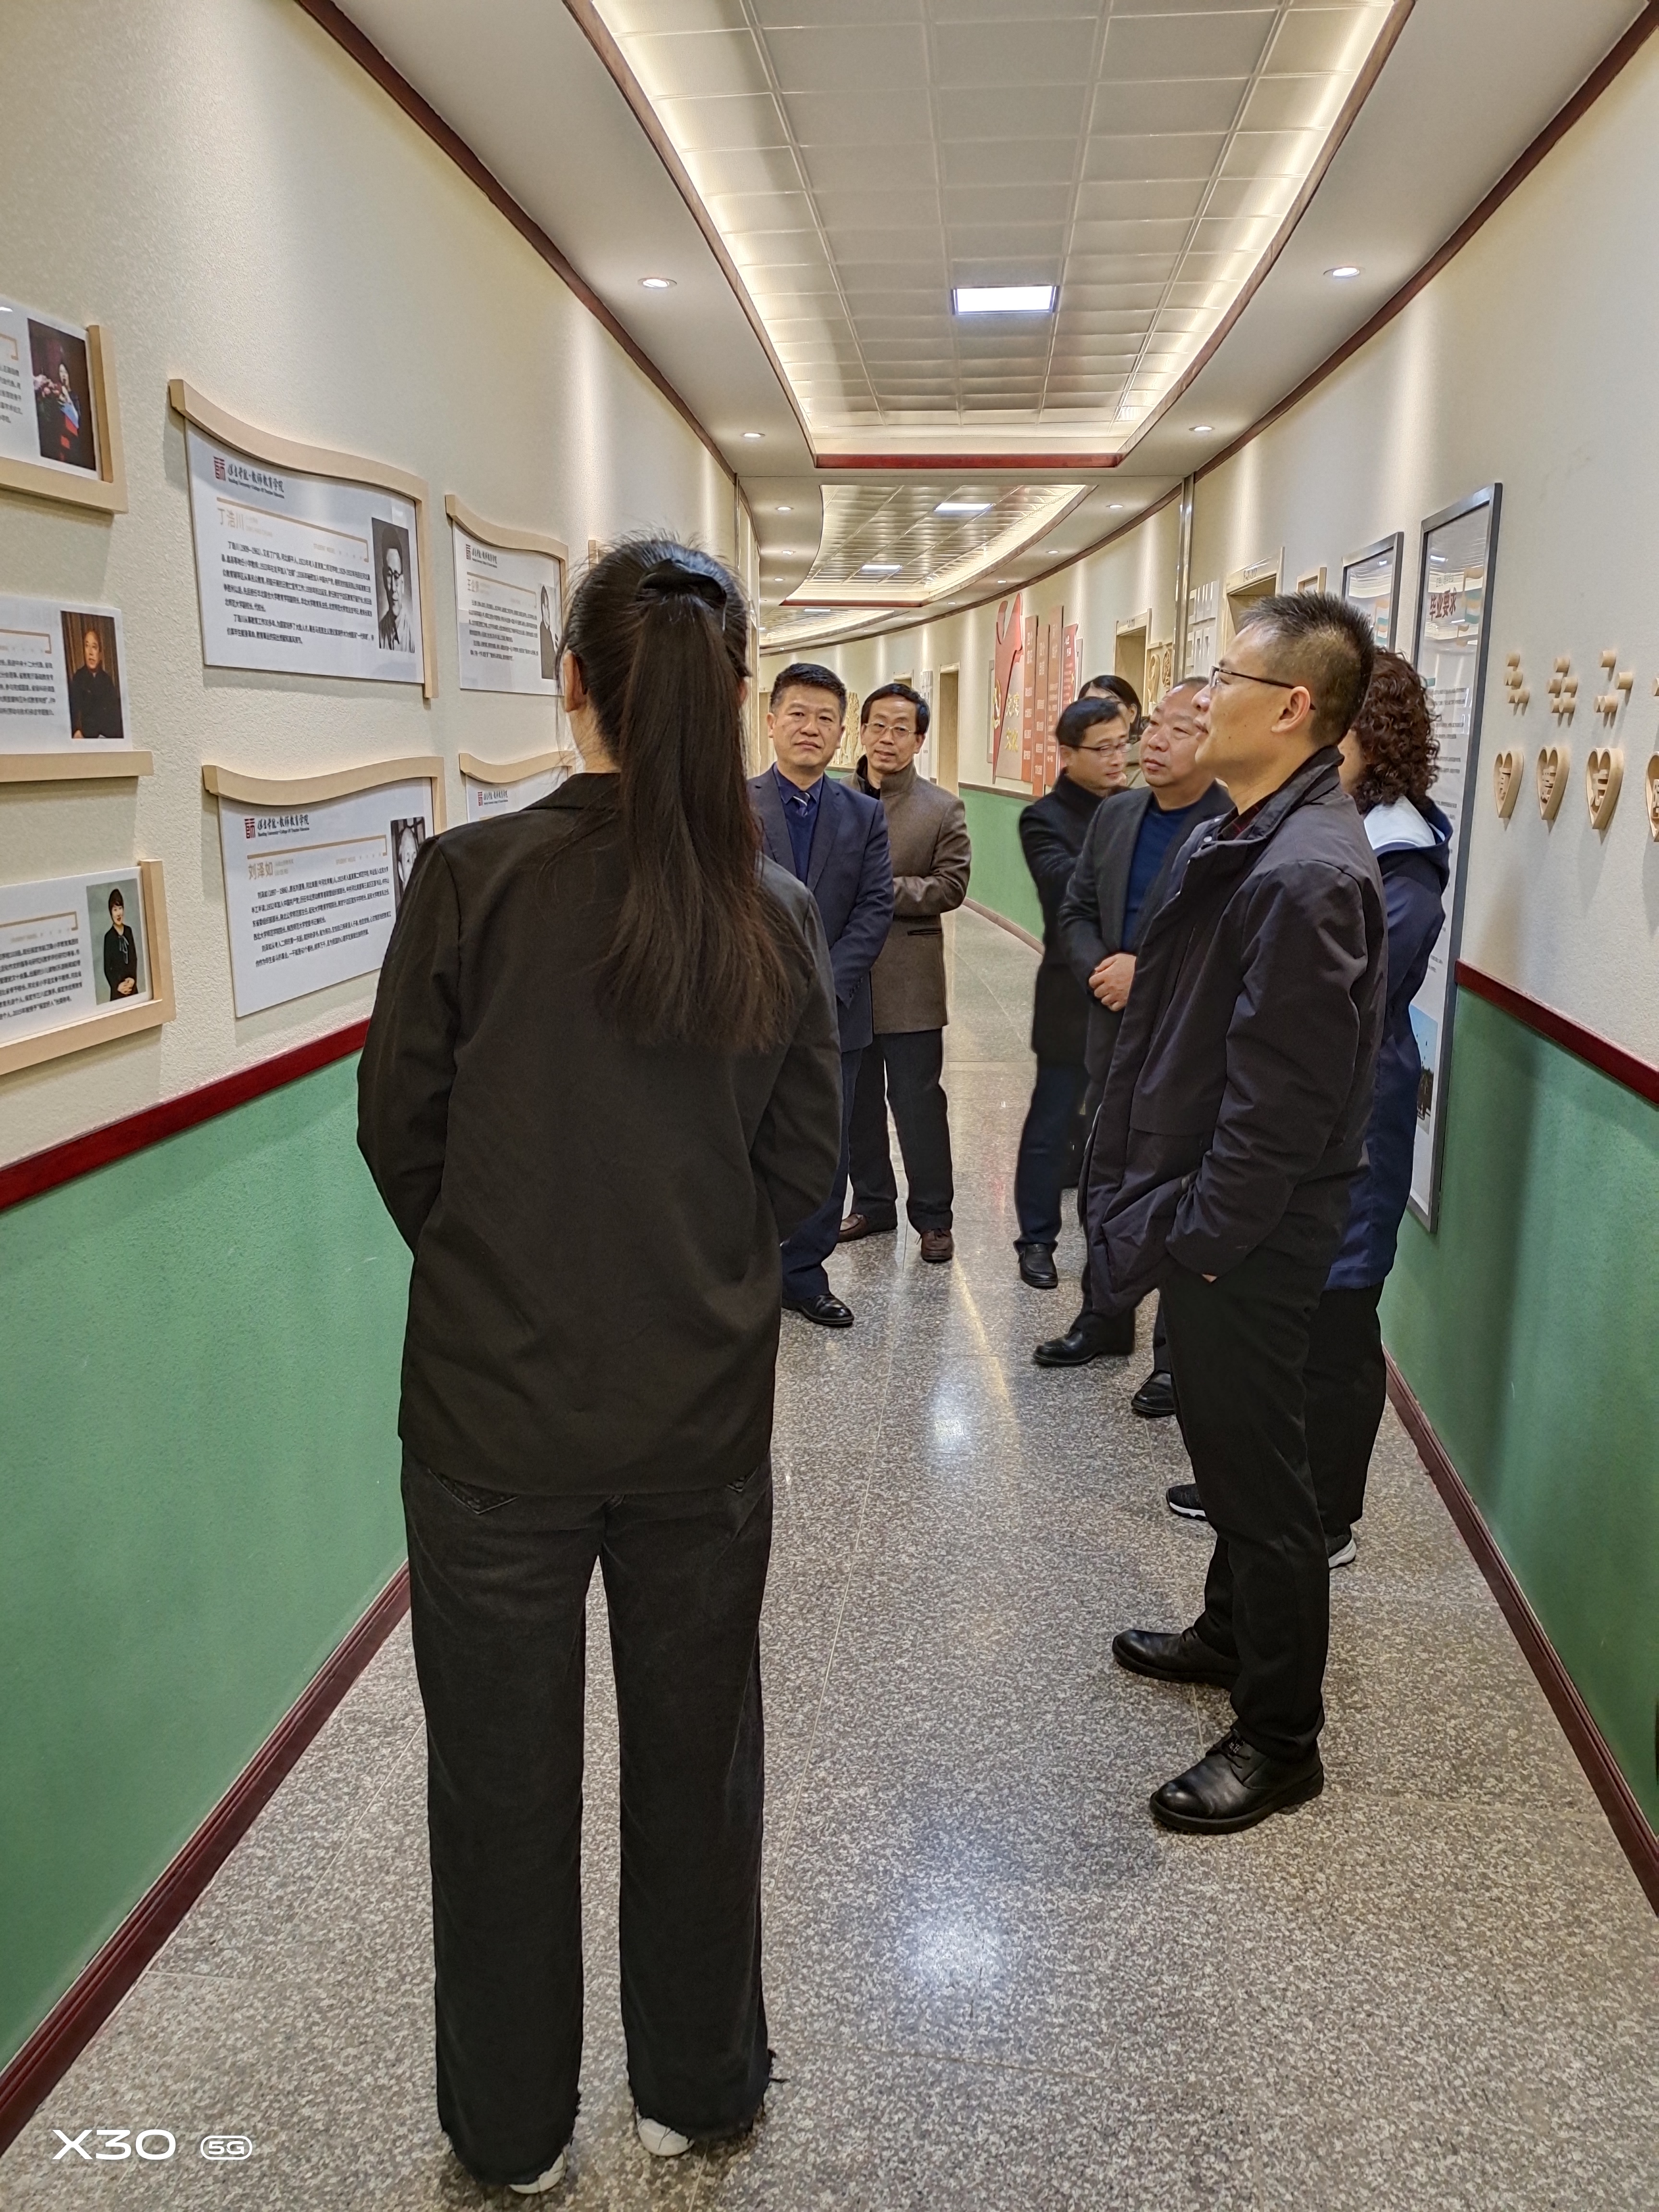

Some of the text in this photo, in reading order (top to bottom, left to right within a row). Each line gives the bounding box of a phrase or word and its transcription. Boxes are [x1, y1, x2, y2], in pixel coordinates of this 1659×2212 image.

[217, 507, 244, 531] 丁浩川
[1430, 587, 1457, 622] 毕业要求
[248, 861, 273, 880] 刘泽如
